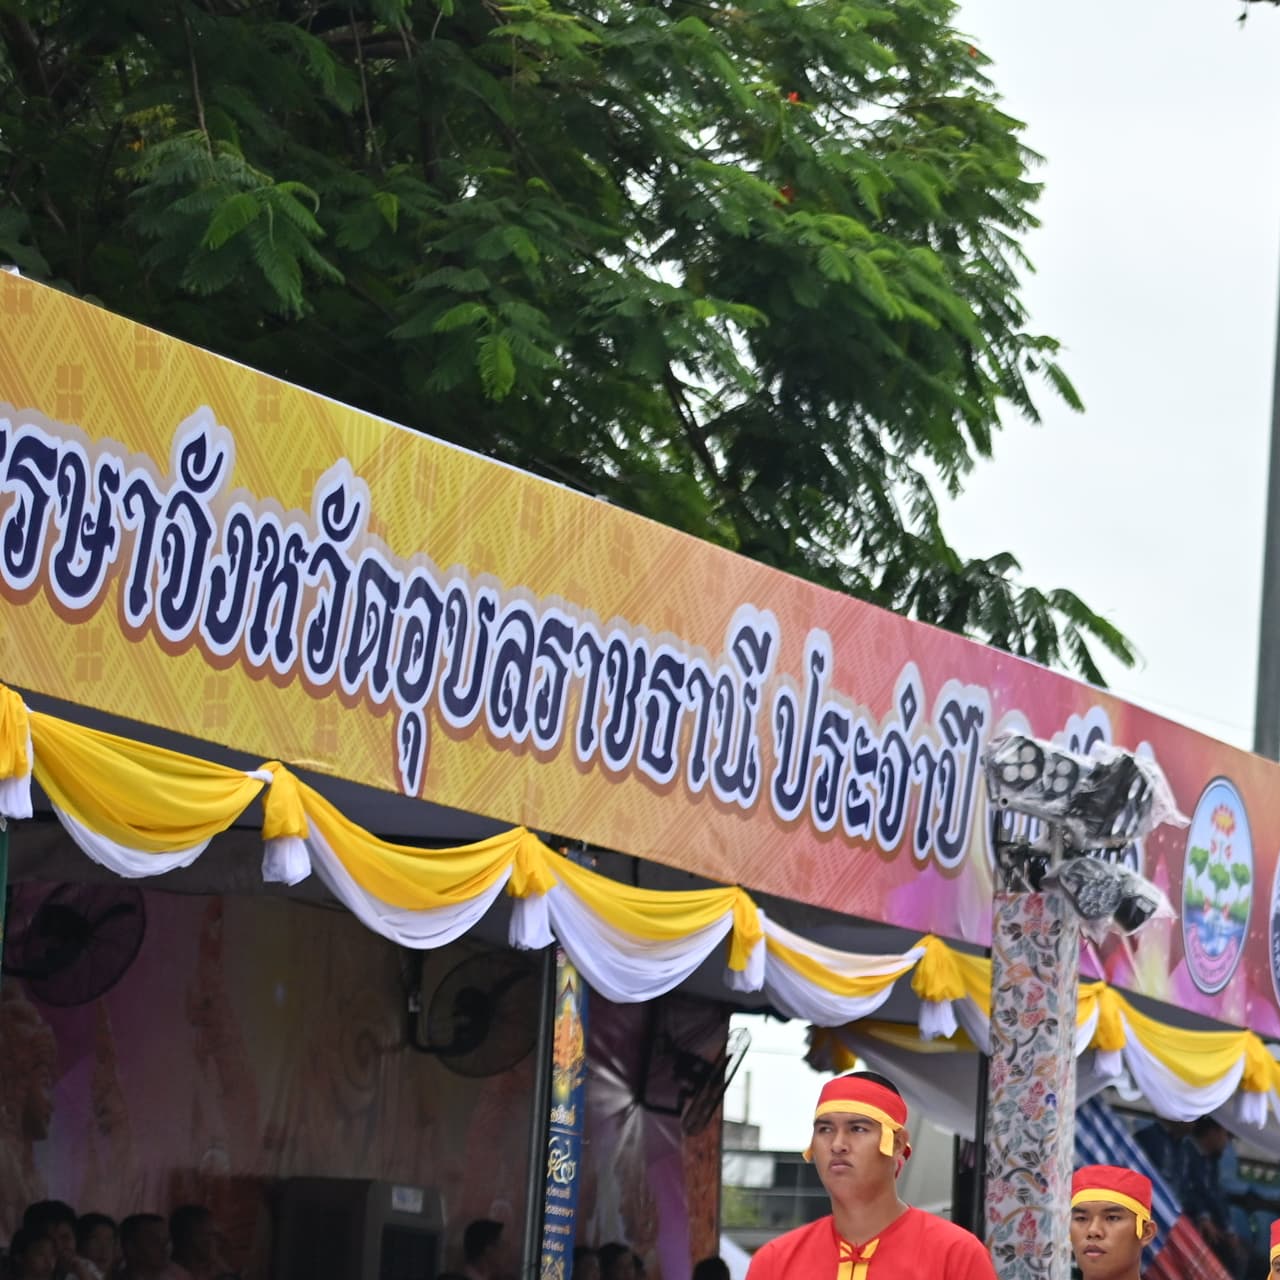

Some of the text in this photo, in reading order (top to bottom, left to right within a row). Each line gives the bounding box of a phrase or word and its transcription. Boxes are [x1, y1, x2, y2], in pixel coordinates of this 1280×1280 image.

[0, 428, 772, 797] รษาจังหวัดอุบลราชธานี
[774, 648, 984, 862] ประจำปี
